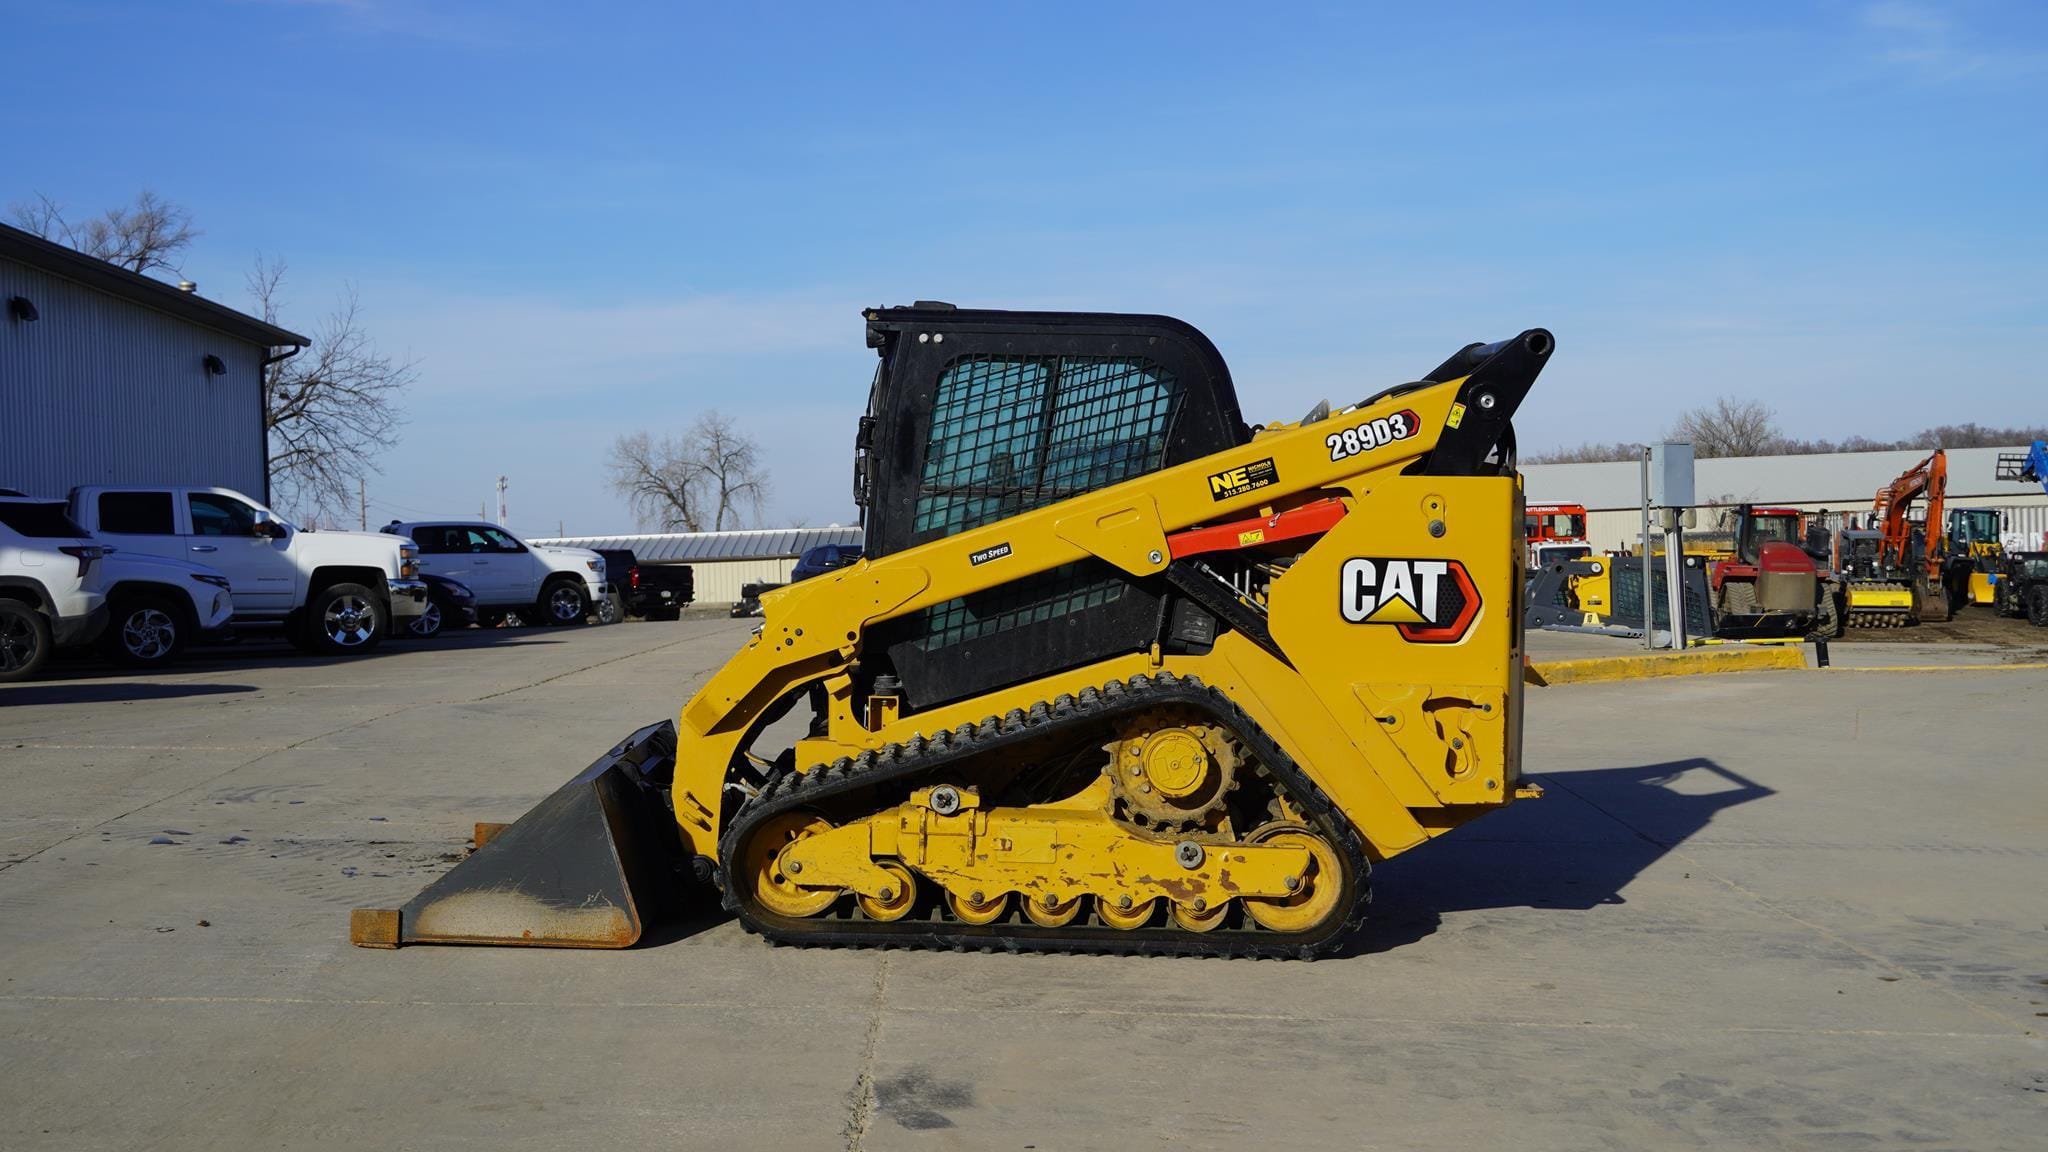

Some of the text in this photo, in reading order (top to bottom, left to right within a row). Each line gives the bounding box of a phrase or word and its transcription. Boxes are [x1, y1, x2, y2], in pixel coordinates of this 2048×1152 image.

[1327, 413, 1408, 461] 289D3
[1210, 467, 1249, 493] NE
[1223, 479, 1269, 497] 515.280.7600
[1342, 558, 1447, 623] CAT
